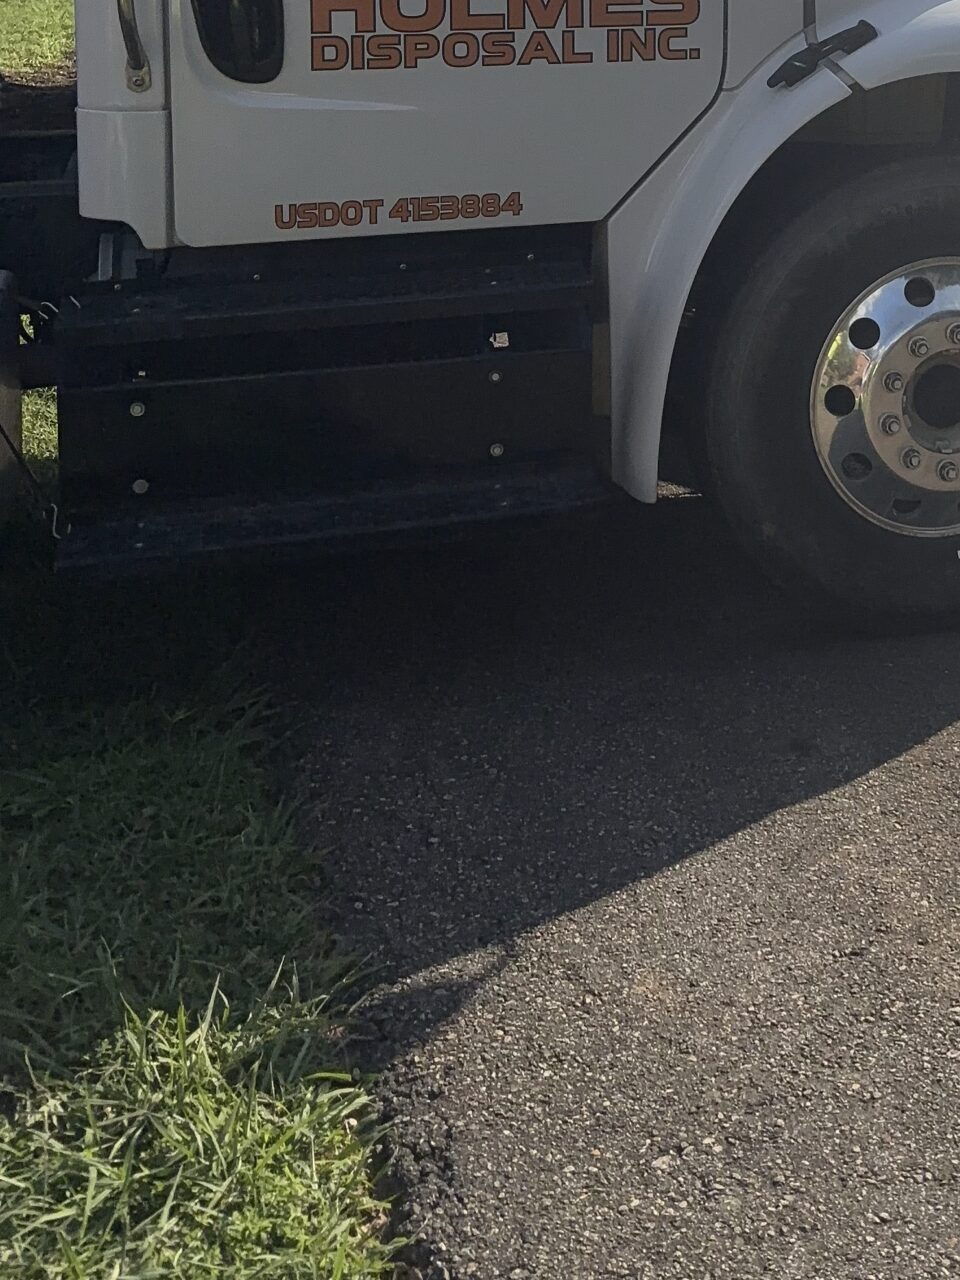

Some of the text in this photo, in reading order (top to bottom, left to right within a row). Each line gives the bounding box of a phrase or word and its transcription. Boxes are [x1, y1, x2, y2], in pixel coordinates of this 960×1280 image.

[310, 26, 701, 71] DISPOSAL INC.
[274, 192, 523, 230] USDOT 4153884
